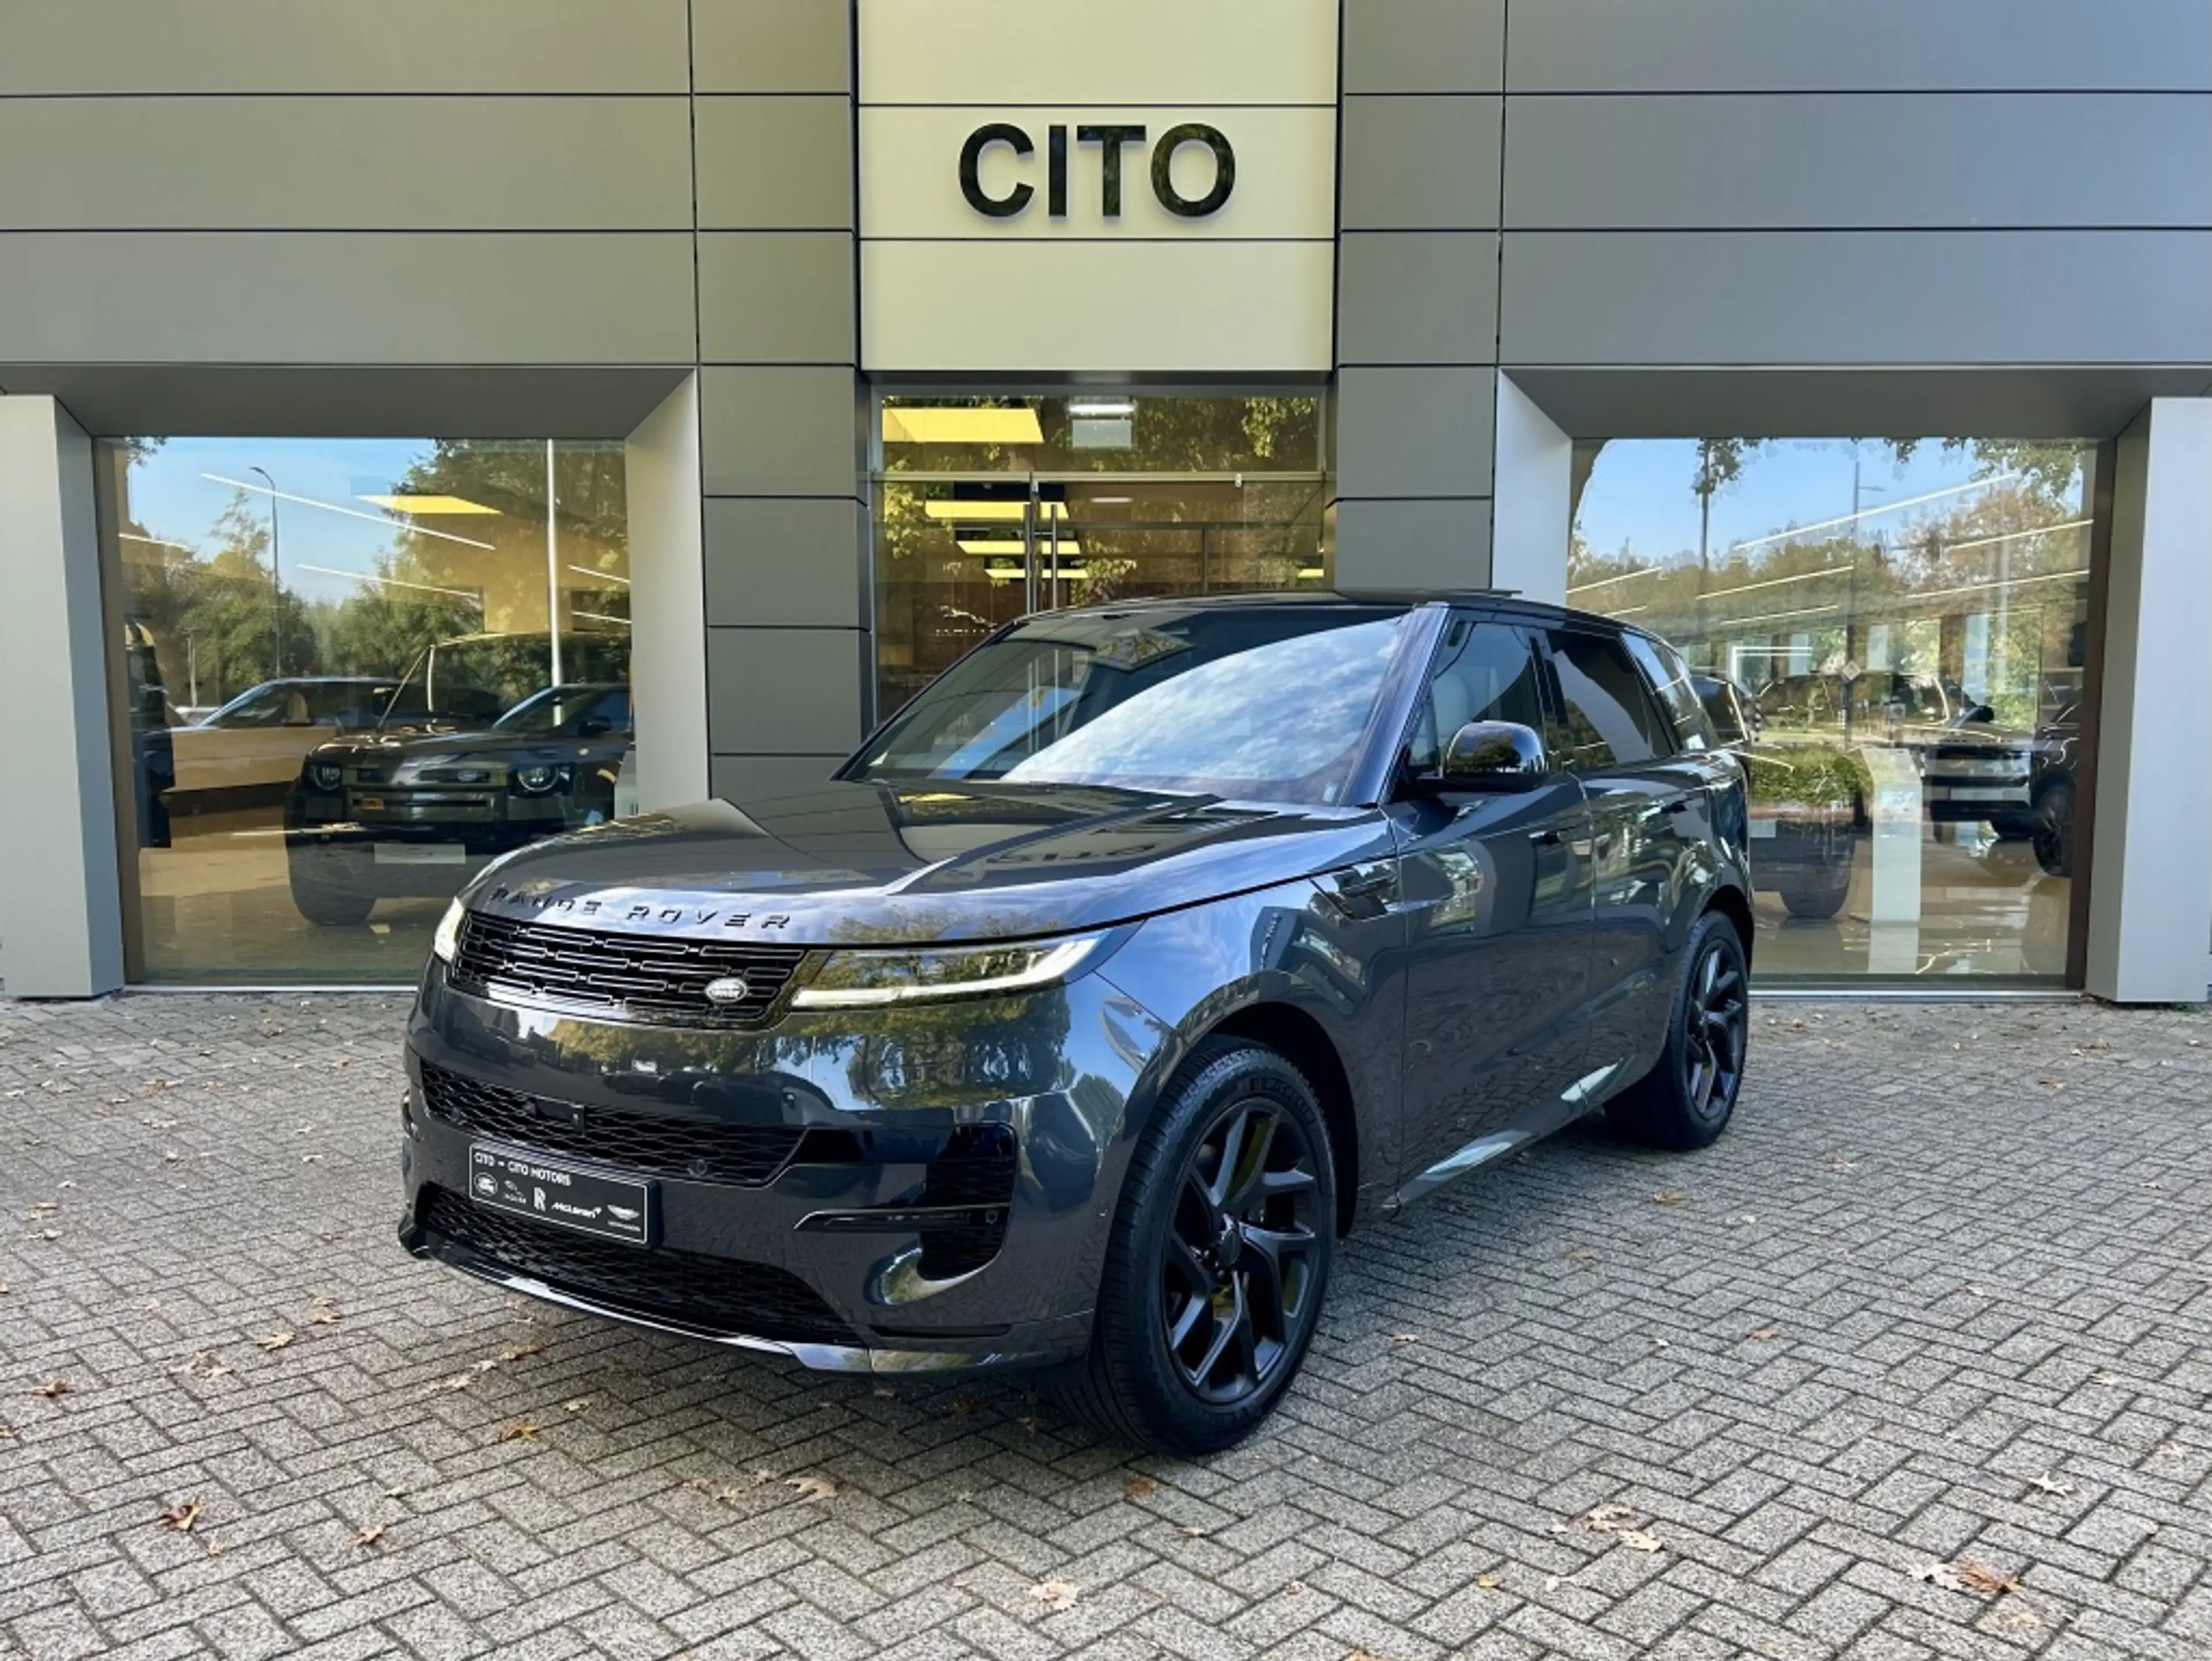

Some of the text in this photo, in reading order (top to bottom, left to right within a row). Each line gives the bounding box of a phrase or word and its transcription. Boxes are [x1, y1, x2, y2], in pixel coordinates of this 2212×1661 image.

[959, 123, 1235, 217] CITO
[491, 887, 789, 929] RANGE ROVER
[530, 1167, 571, 1186] MOTORS
